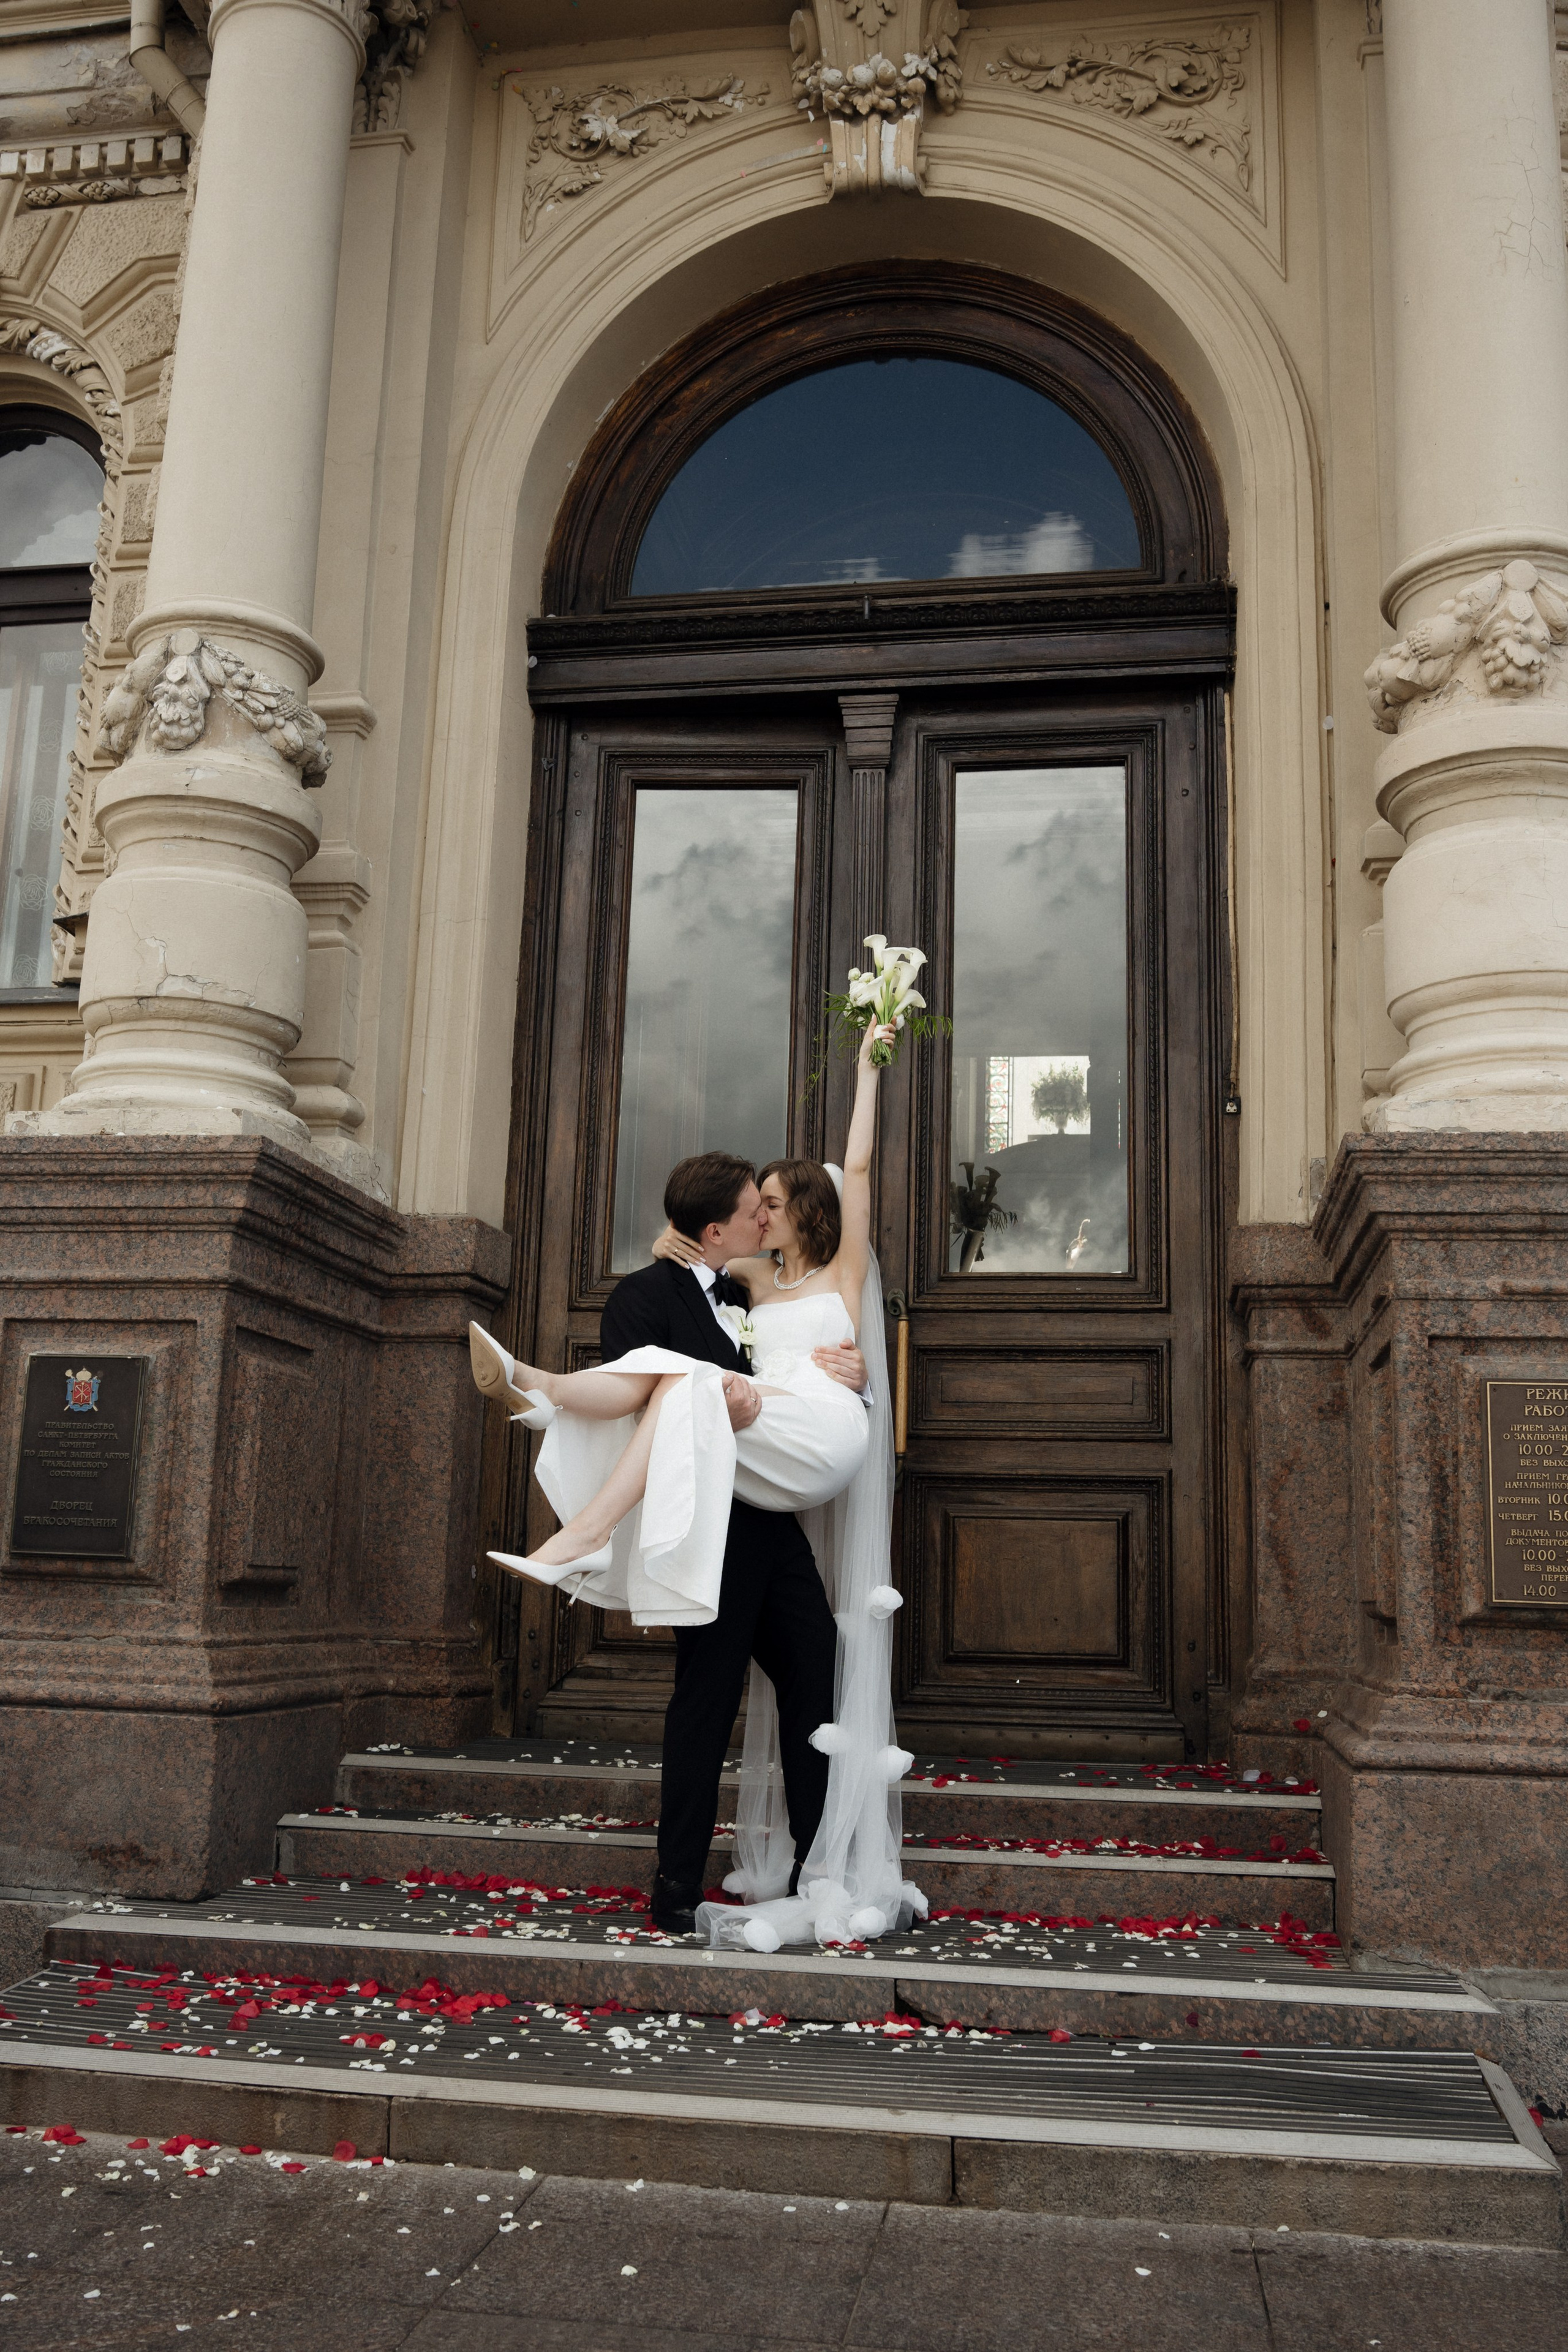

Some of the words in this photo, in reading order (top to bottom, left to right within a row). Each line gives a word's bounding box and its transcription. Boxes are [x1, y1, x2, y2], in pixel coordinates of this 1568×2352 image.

[42, 1460, 108, 1469] ГРАЖДАНСКОГО
[50, 1501, 93, 1511] ДВОРЕЦ
[23, 1517, 118, 1527] БРАКОСОЧЕТАНИЯ
[1523, 1585, 1556, 1597] 14.00
